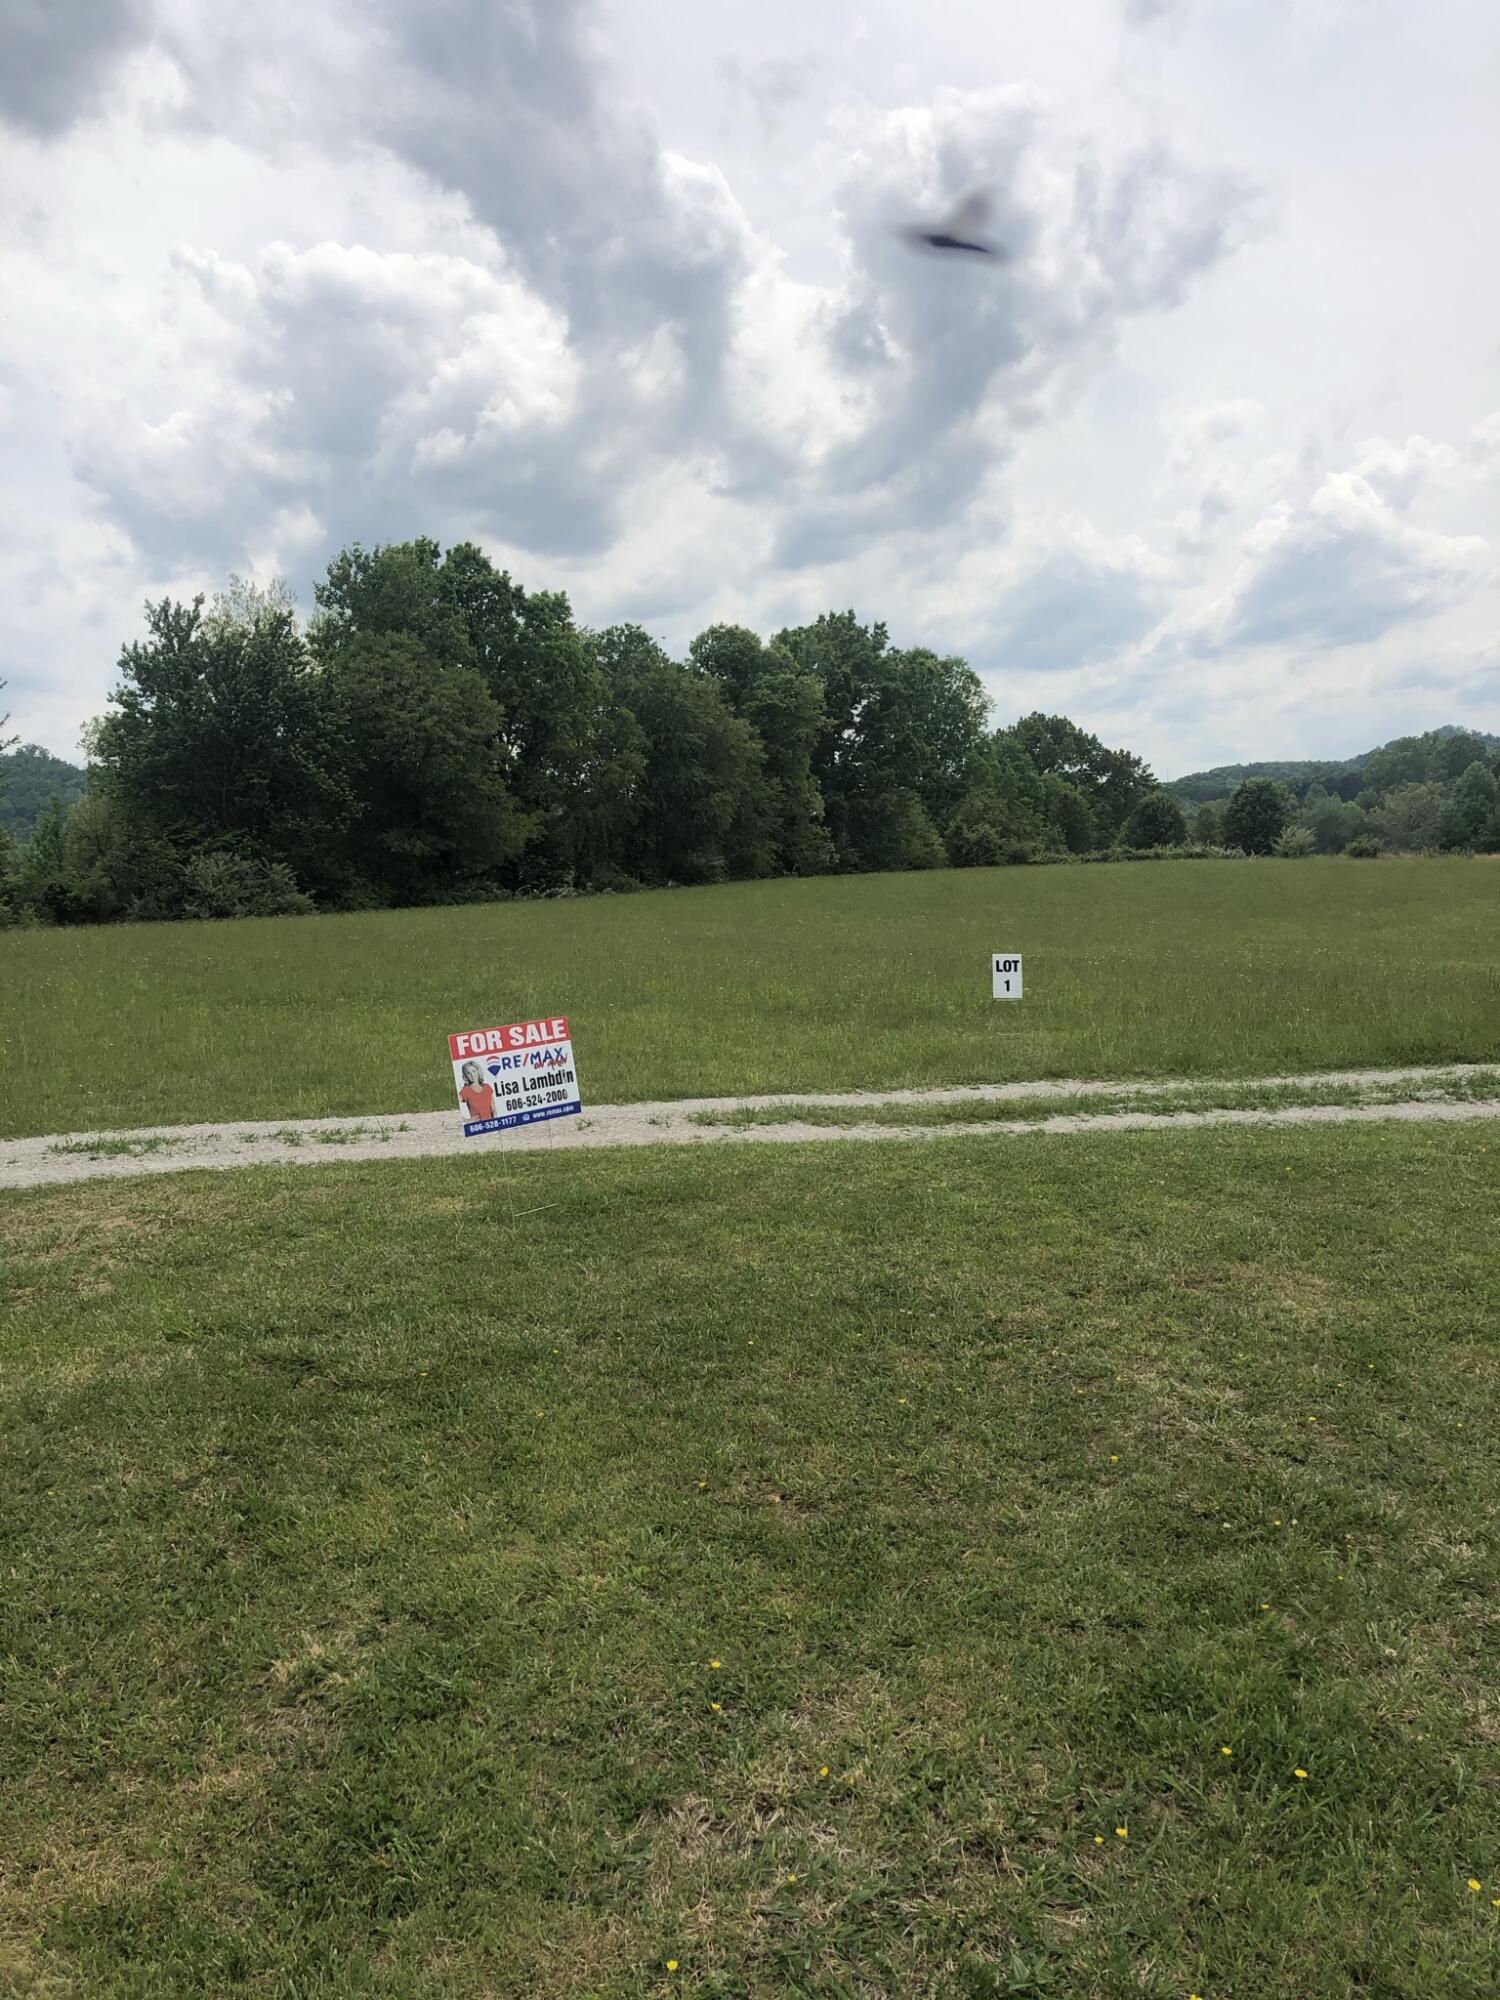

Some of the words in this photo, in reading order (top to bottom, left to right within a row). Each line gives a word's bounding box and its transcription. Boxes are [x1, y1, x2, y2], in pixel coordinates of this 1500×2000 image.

[996, 960, 1020, 973] LOT
[1004, 979, 1010, 992] 1
[456, 1030, 503, 1056] FOR
[508, 1019, 567, 1046] SALE
[502, 1047, 564, 1070] RE/MAX
[493, 1080, 519, 1097] Lisa
[522, 1069, 574, 1091] Lambdin
[506, 1089, 568, 1111] 606-524-2000
